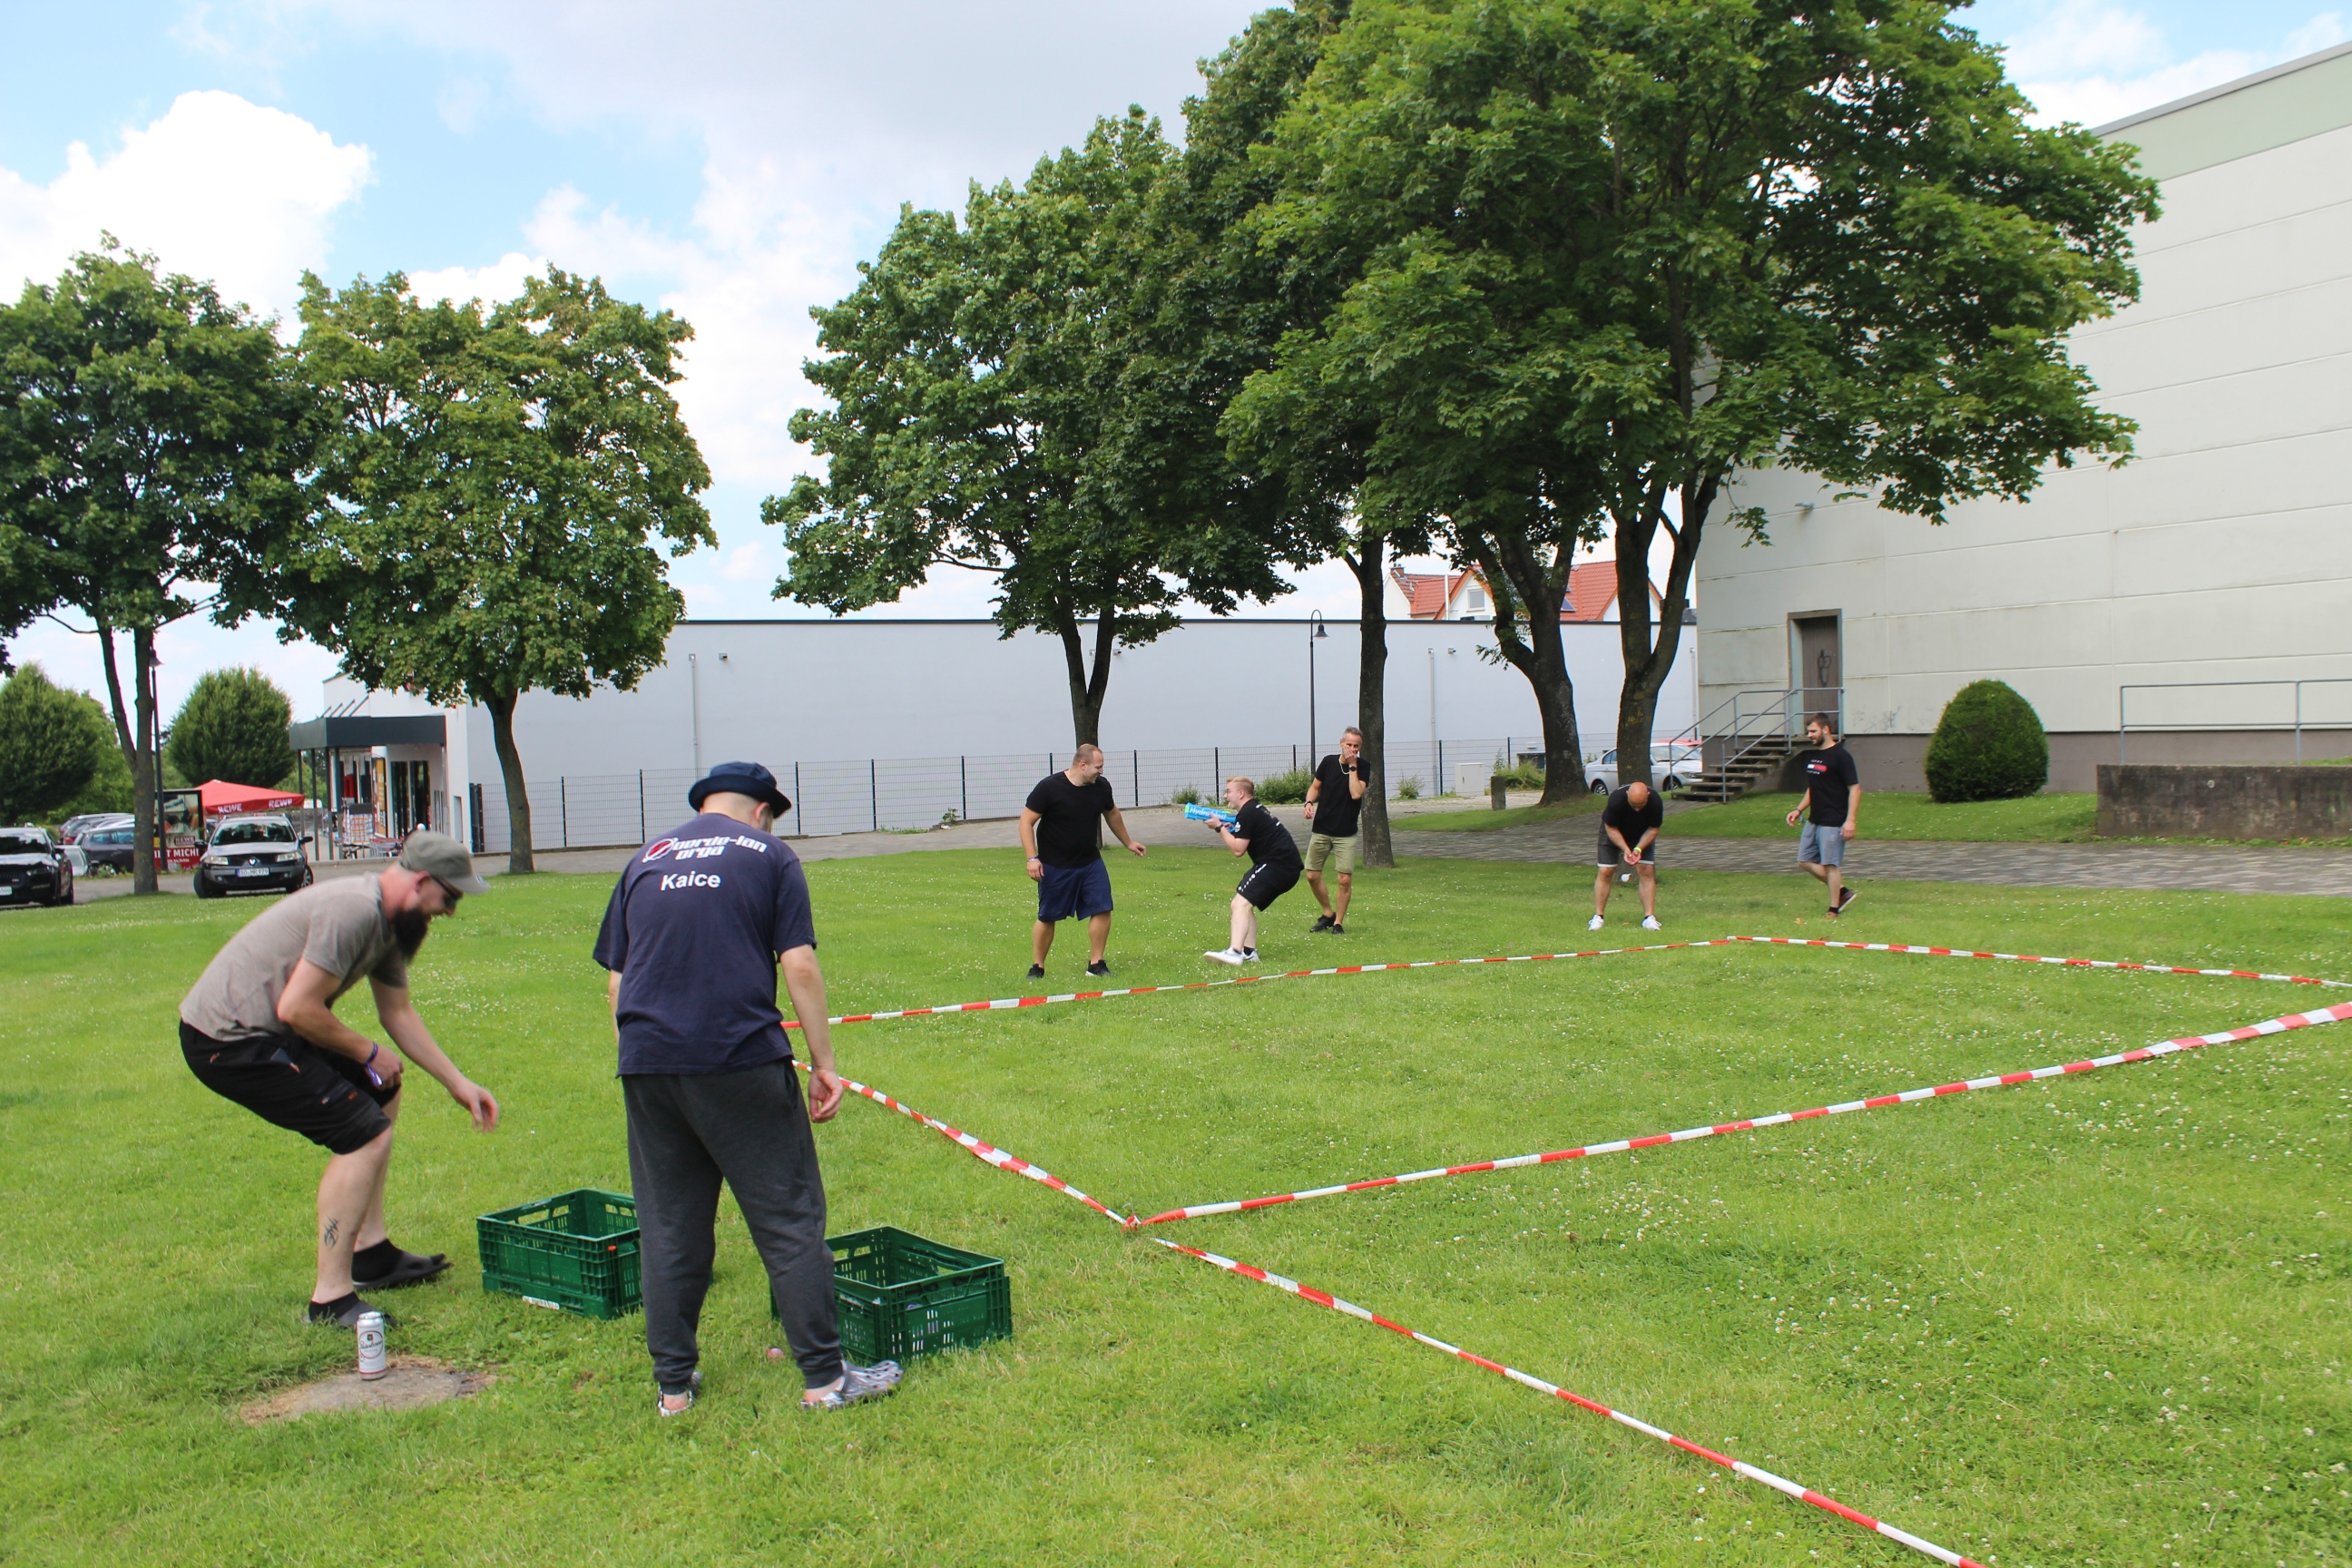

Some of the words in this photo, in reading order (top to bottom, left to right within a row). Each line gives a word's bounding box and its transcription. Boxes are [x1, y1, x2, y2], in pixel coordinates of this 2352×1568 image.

[218, 804, 241, 814] REWE
[173, 848, 200, 858] MICH!
[675, 844, 726, 860] orga
[661, 870, 721, 891] Kaice
